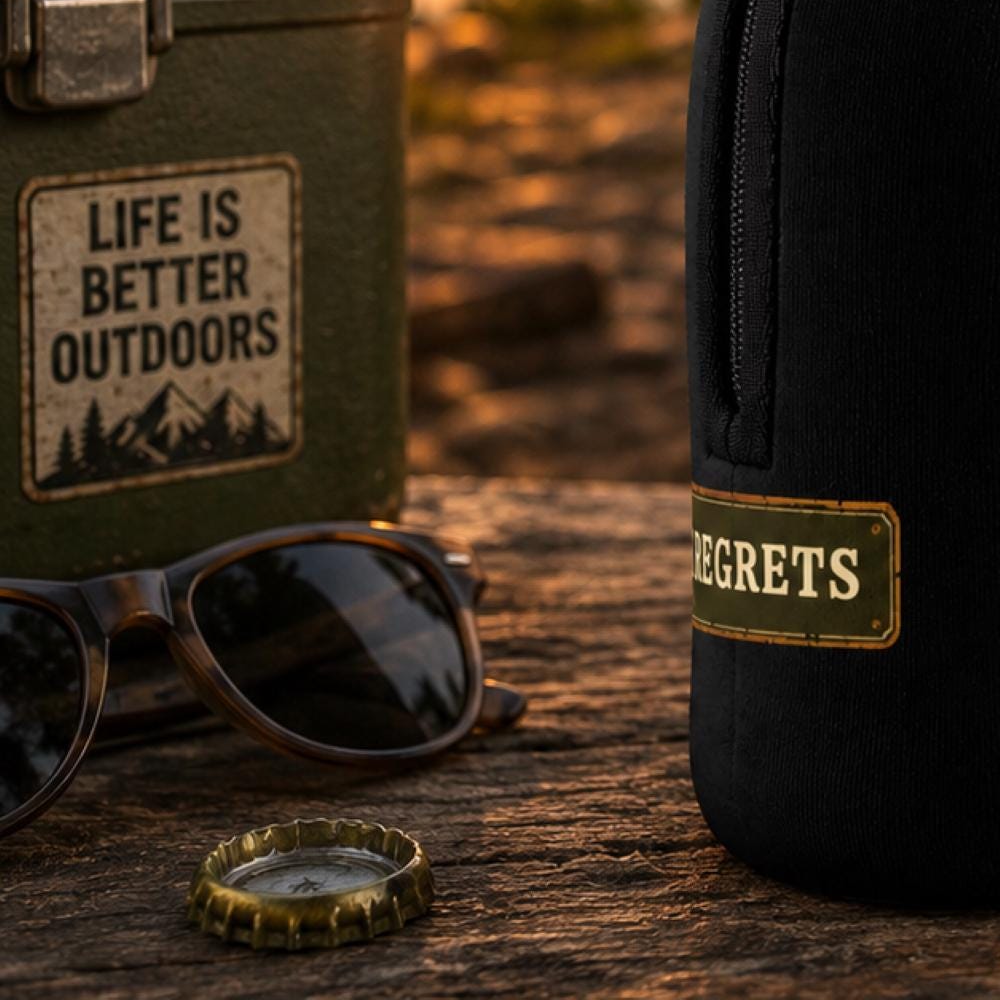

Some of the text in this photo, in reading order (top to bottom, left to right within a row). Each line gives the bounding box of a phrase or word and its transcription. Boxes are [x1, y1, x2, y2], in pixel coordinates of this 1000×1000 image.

[88, 187, 241, 252] LIFE IS
[81, 252, 249, 318] BETTER
[51, 307, 280, 384] OUTDOORS
[694, 529, 860, 601] REGRETS
